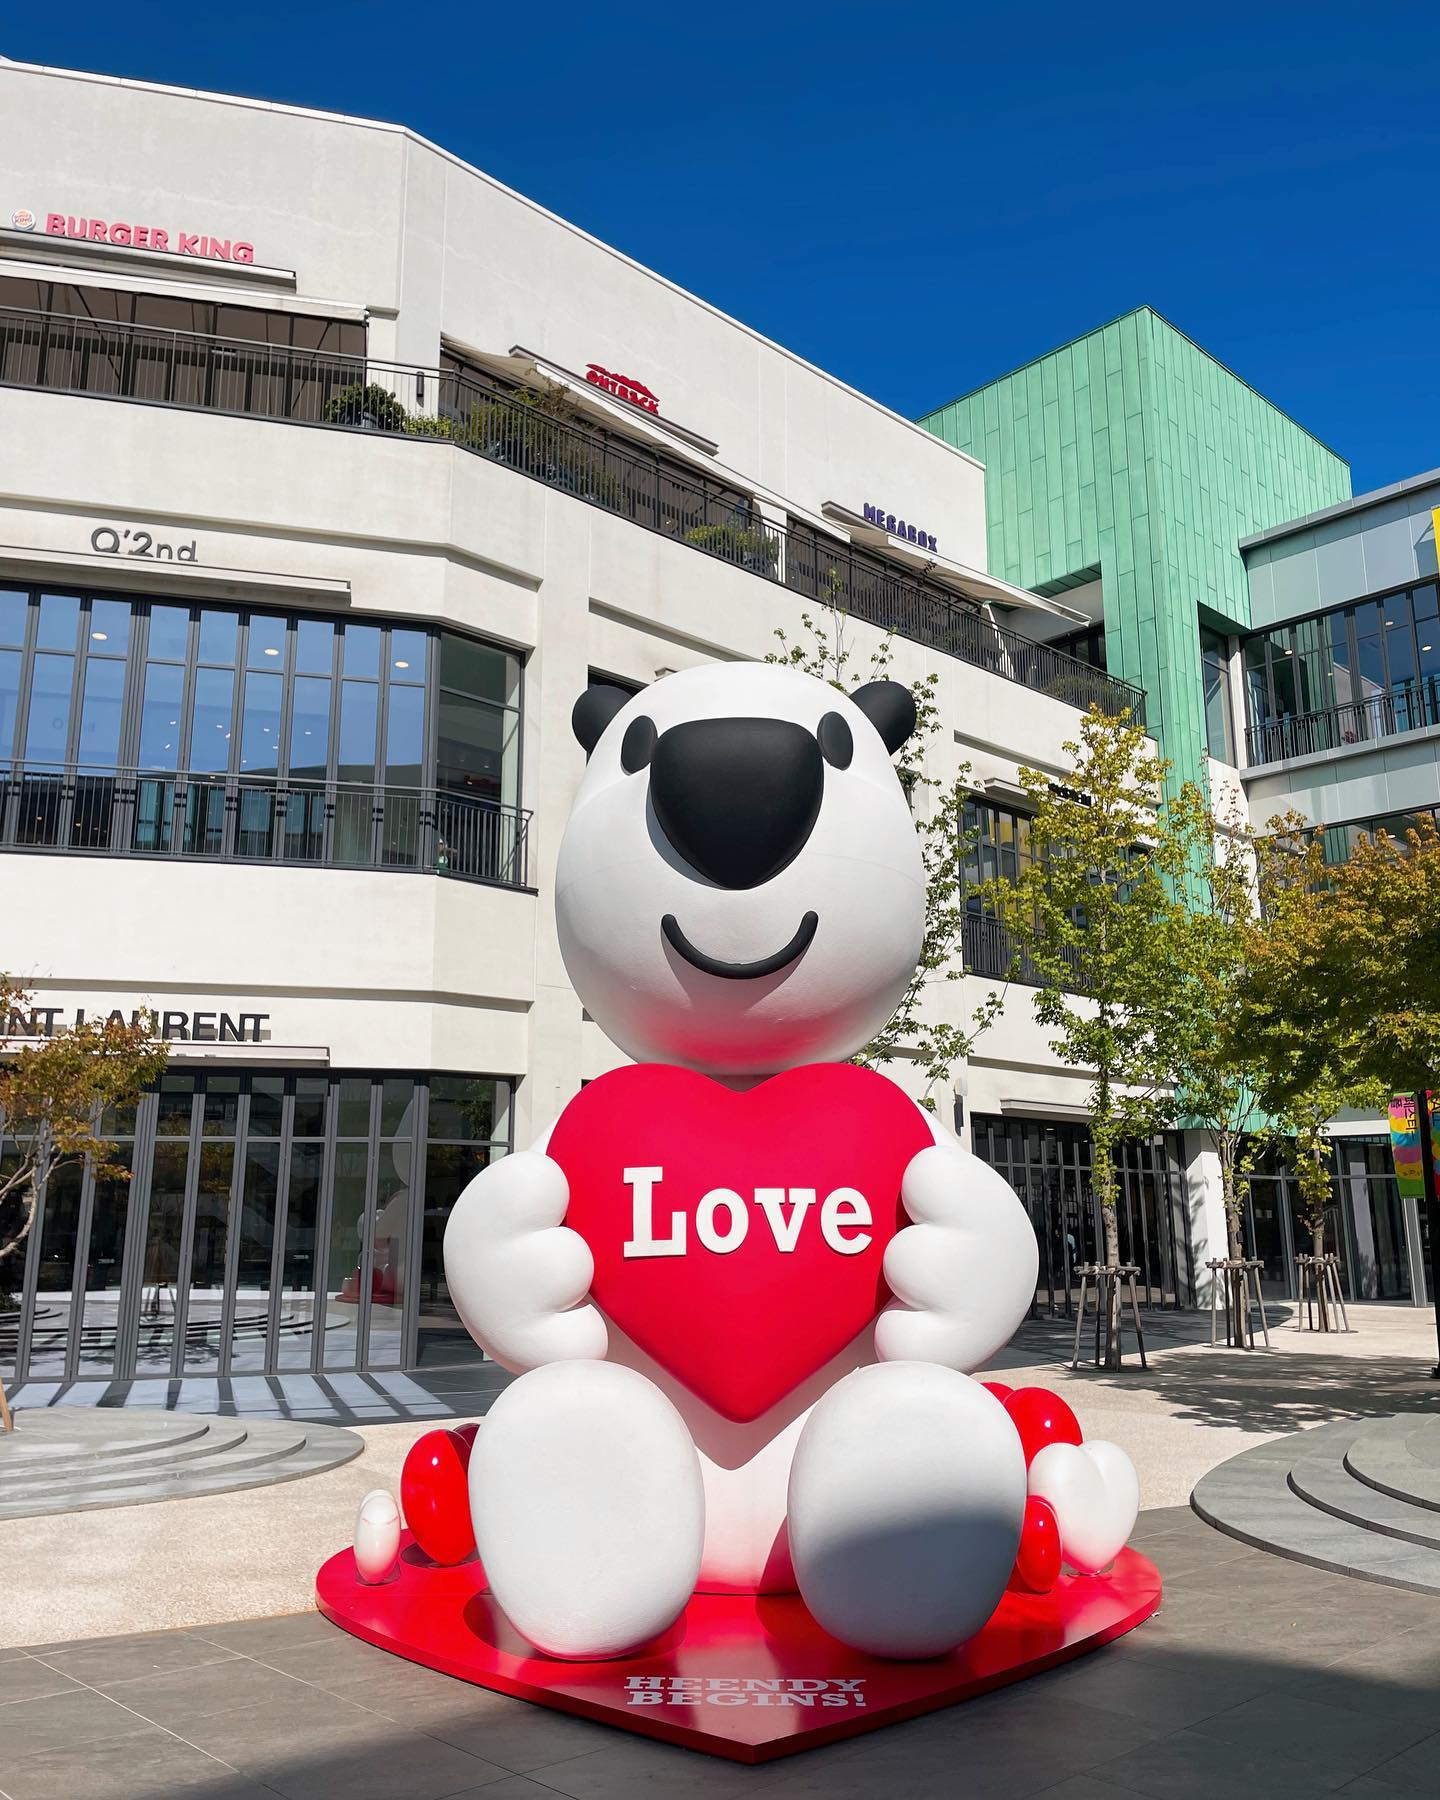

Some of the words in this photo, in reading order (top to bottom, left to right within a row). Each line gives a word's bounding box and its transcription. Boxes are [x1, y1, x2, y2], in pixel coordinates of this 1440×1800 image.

[46, 213, 169, 250] BURGER
[178, 232, 255, 263] KING
[586, 369, 659, 416] OUTBACK
[863, 502, 938, 553] MEGABOX
[623, 1166, 873, 1258] Love
[624, 1676, 866, 1692] HEENDY
[627, 1691, 866, 1707] BEGINS!
